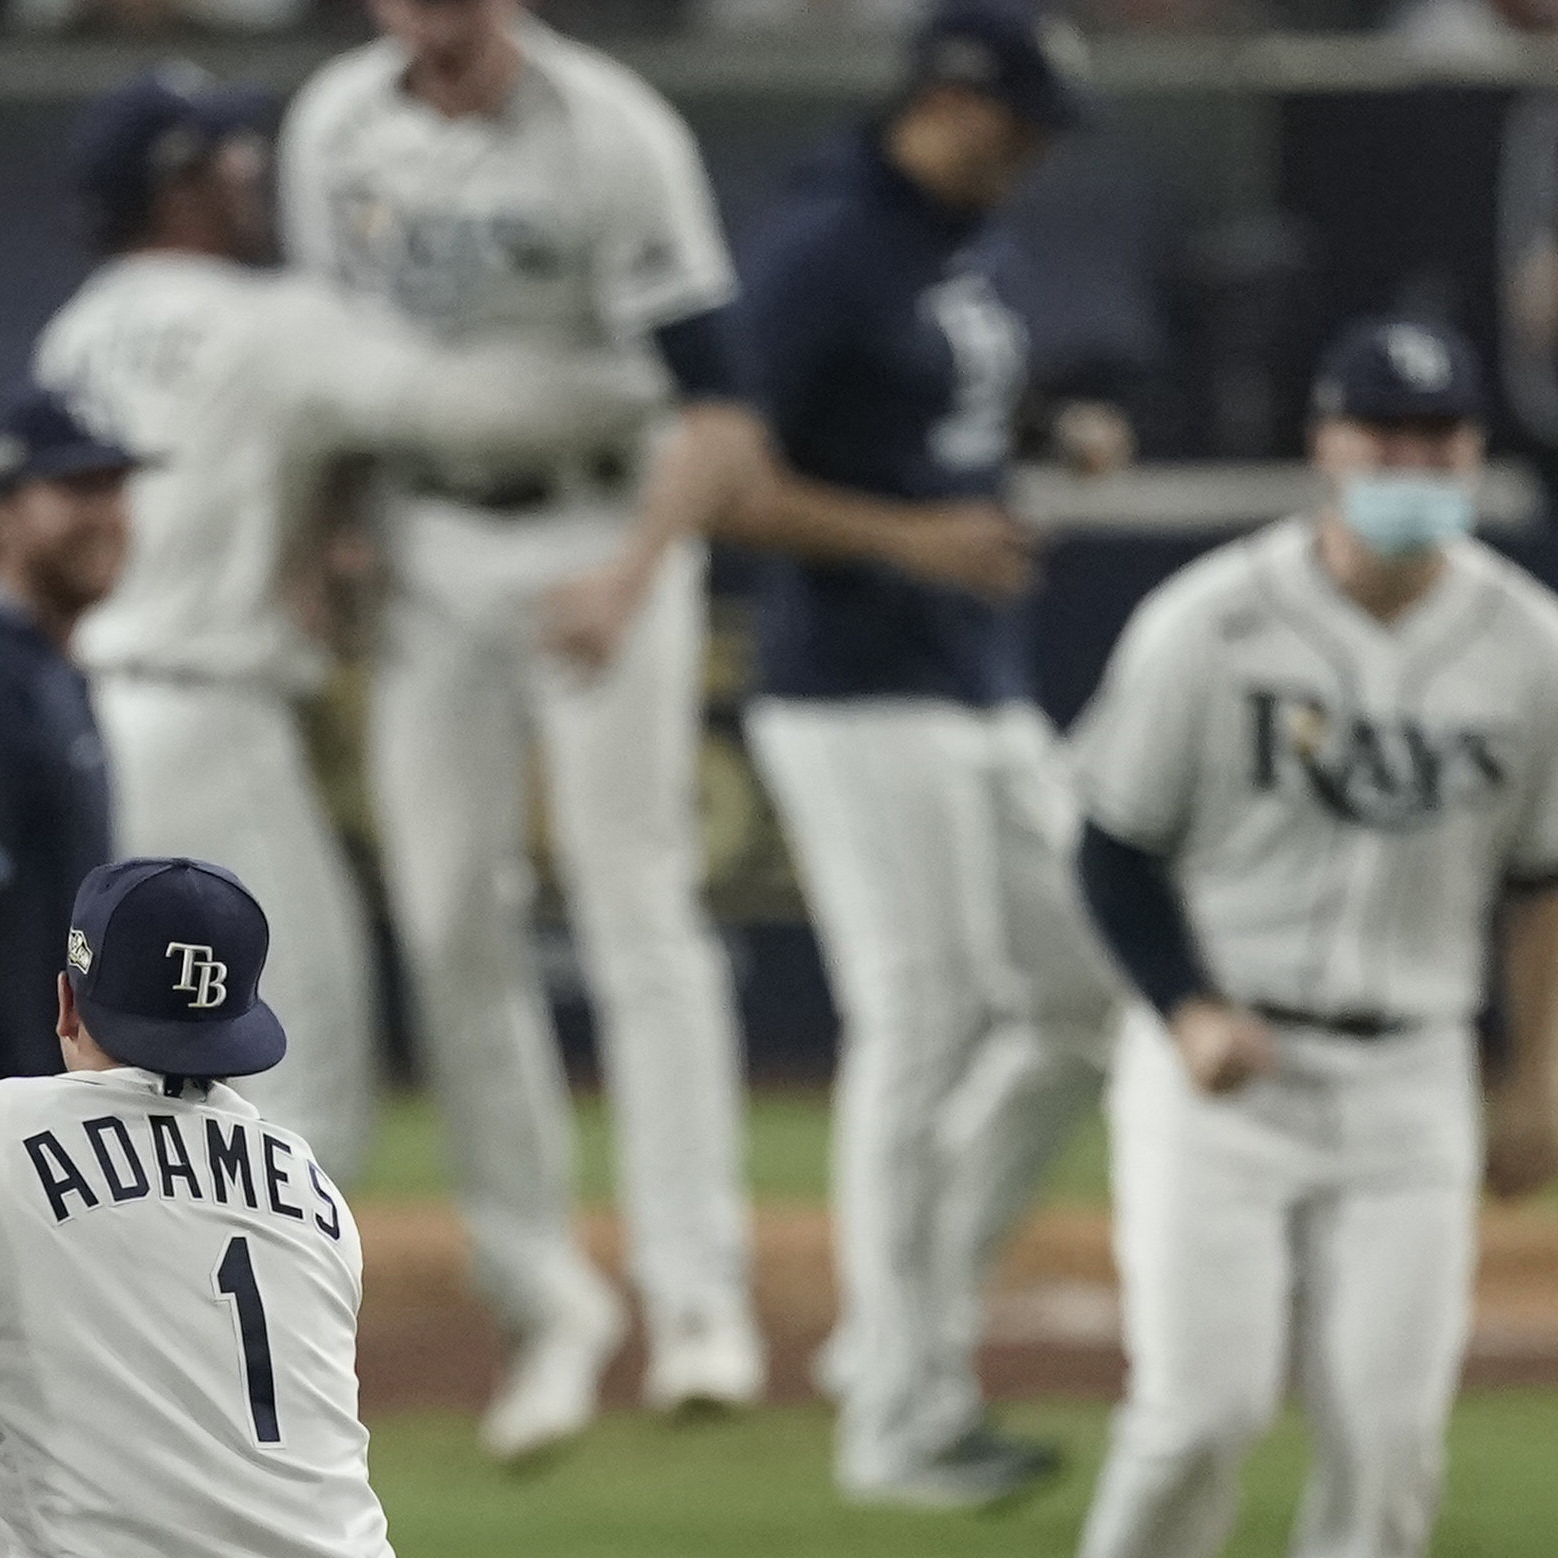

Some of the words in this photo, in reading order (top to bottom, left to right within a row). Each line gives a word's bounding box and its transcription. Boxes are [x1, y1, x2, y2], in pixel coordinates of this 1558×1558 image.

[164, 940, 228, 1008] TB
[21, 1114, 341, 1241] ADAMES
[213, 1233, 284, 1446] 1
